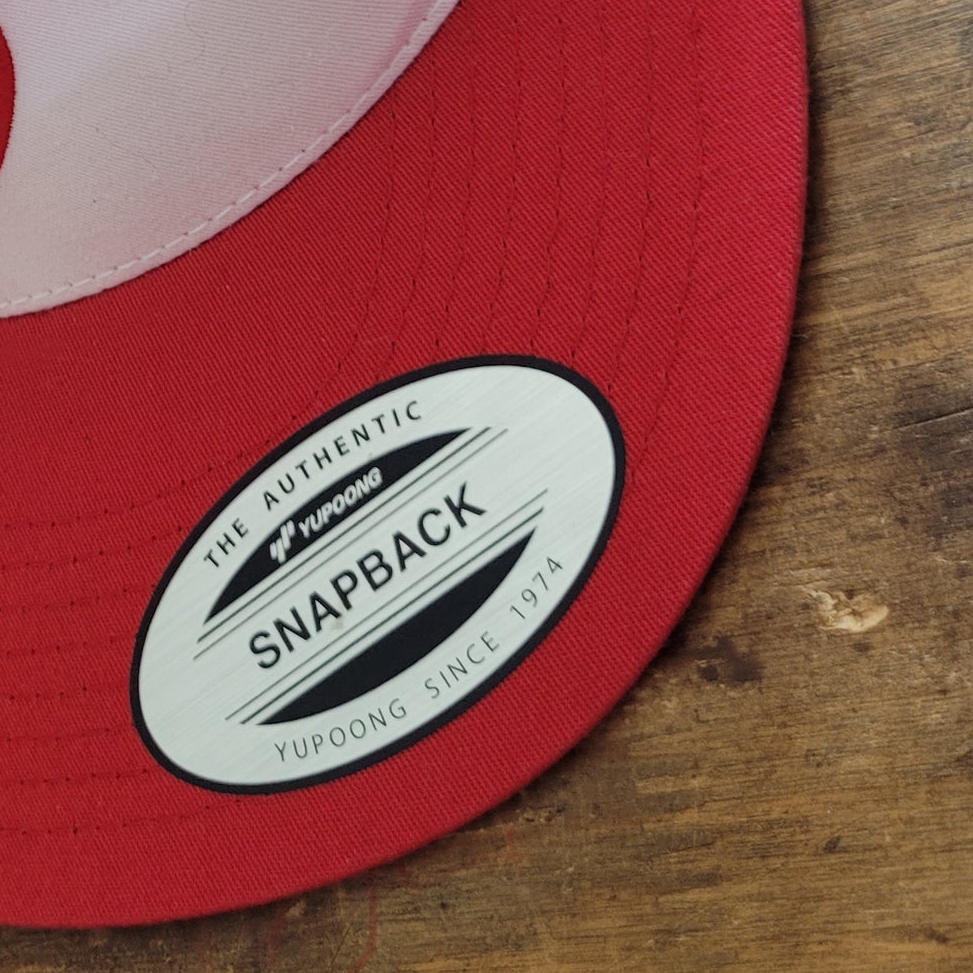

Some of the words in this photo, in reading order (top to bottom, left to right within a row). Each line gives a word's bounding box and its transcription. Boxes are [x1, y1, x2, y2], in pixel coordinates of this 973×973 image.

[203, 517, 249, 570] THE
[261, 400, 424, 512] AUTHENTIC
[297, 466, 383, 539] YUPOONG
[248, 481, 488, 670] SNAPBACK
[273, 698, 408, 763] YUPOONG
[423, 630, 500, 700] SINCE
[509, 555, 564, 622] 1974
